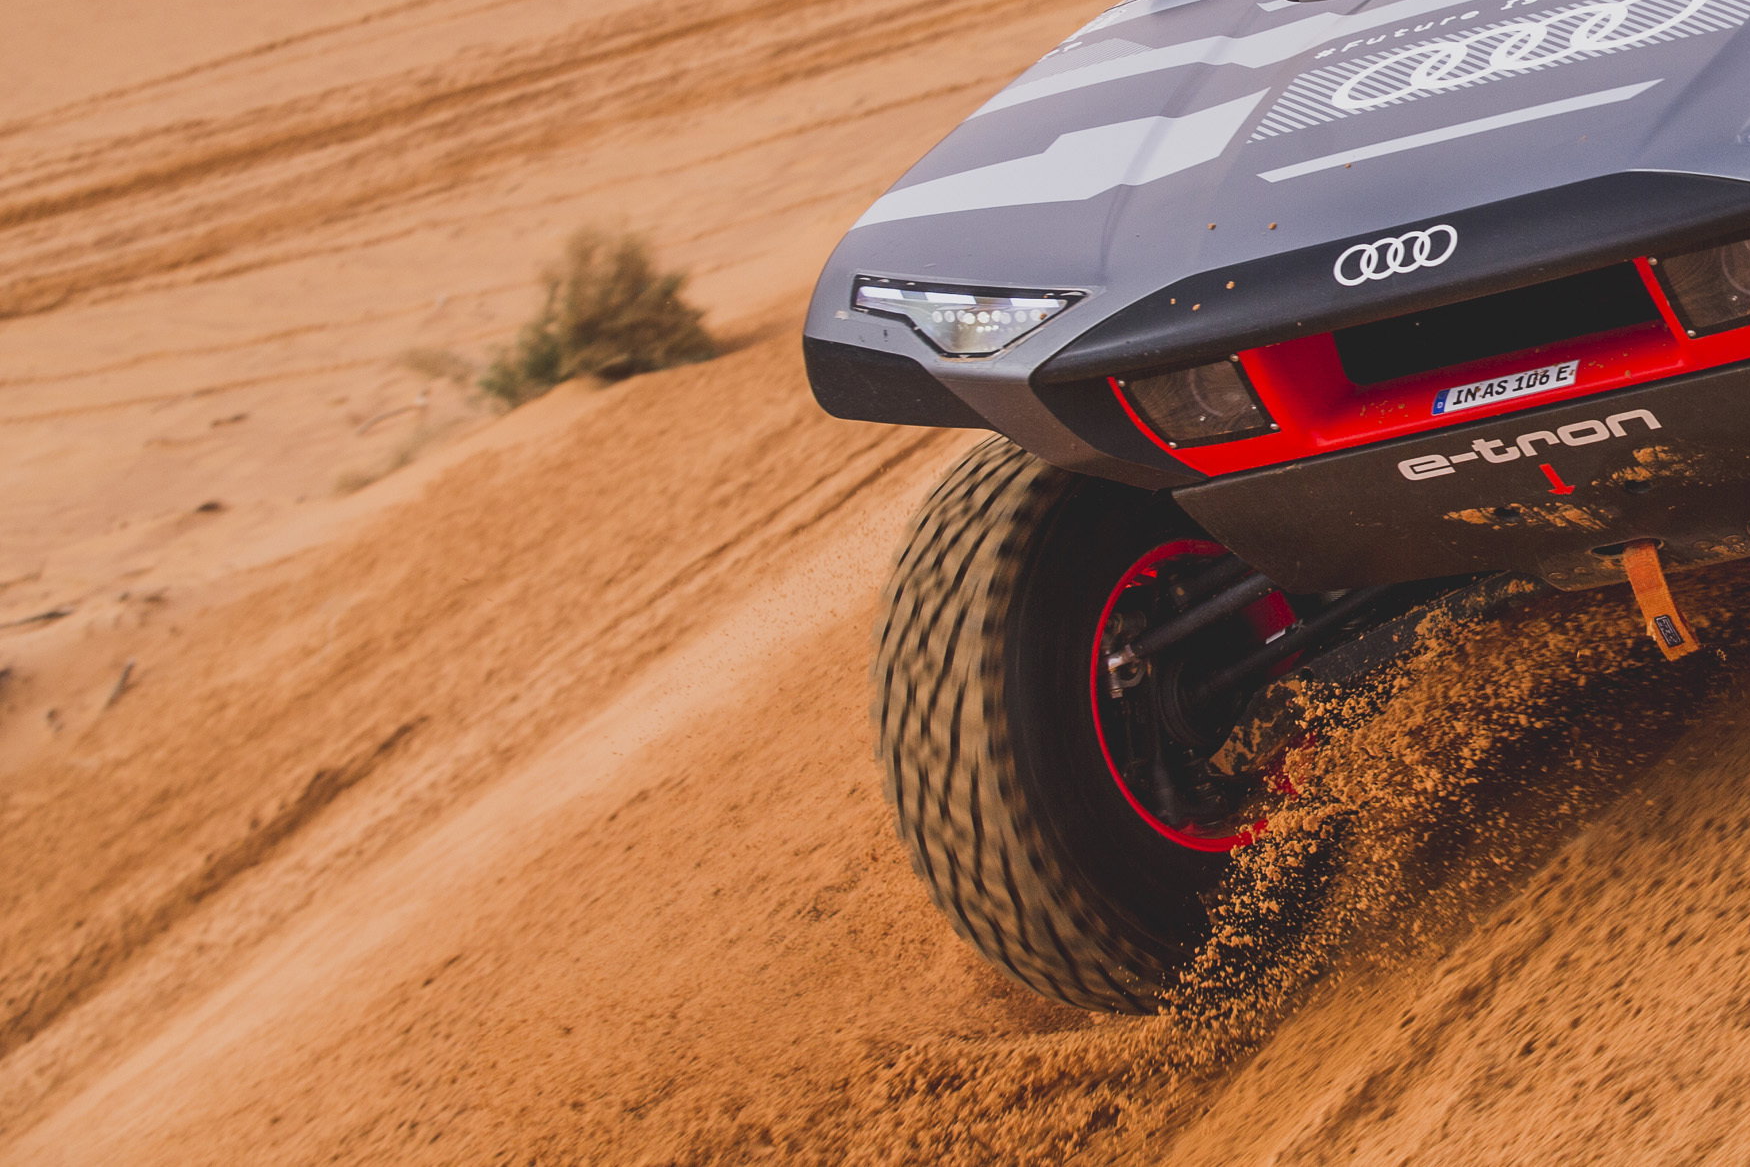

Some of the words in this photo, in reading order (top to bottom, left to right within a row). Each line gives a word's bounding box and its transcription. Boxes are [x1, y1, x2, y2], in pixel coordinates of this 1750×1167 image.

[1452, 385, 1479, 406] IN
[1481, 379, 1507, 398] AS
[1555, 364, 1571, 381] E
[1396, 408, 1663, 482] e-tron
